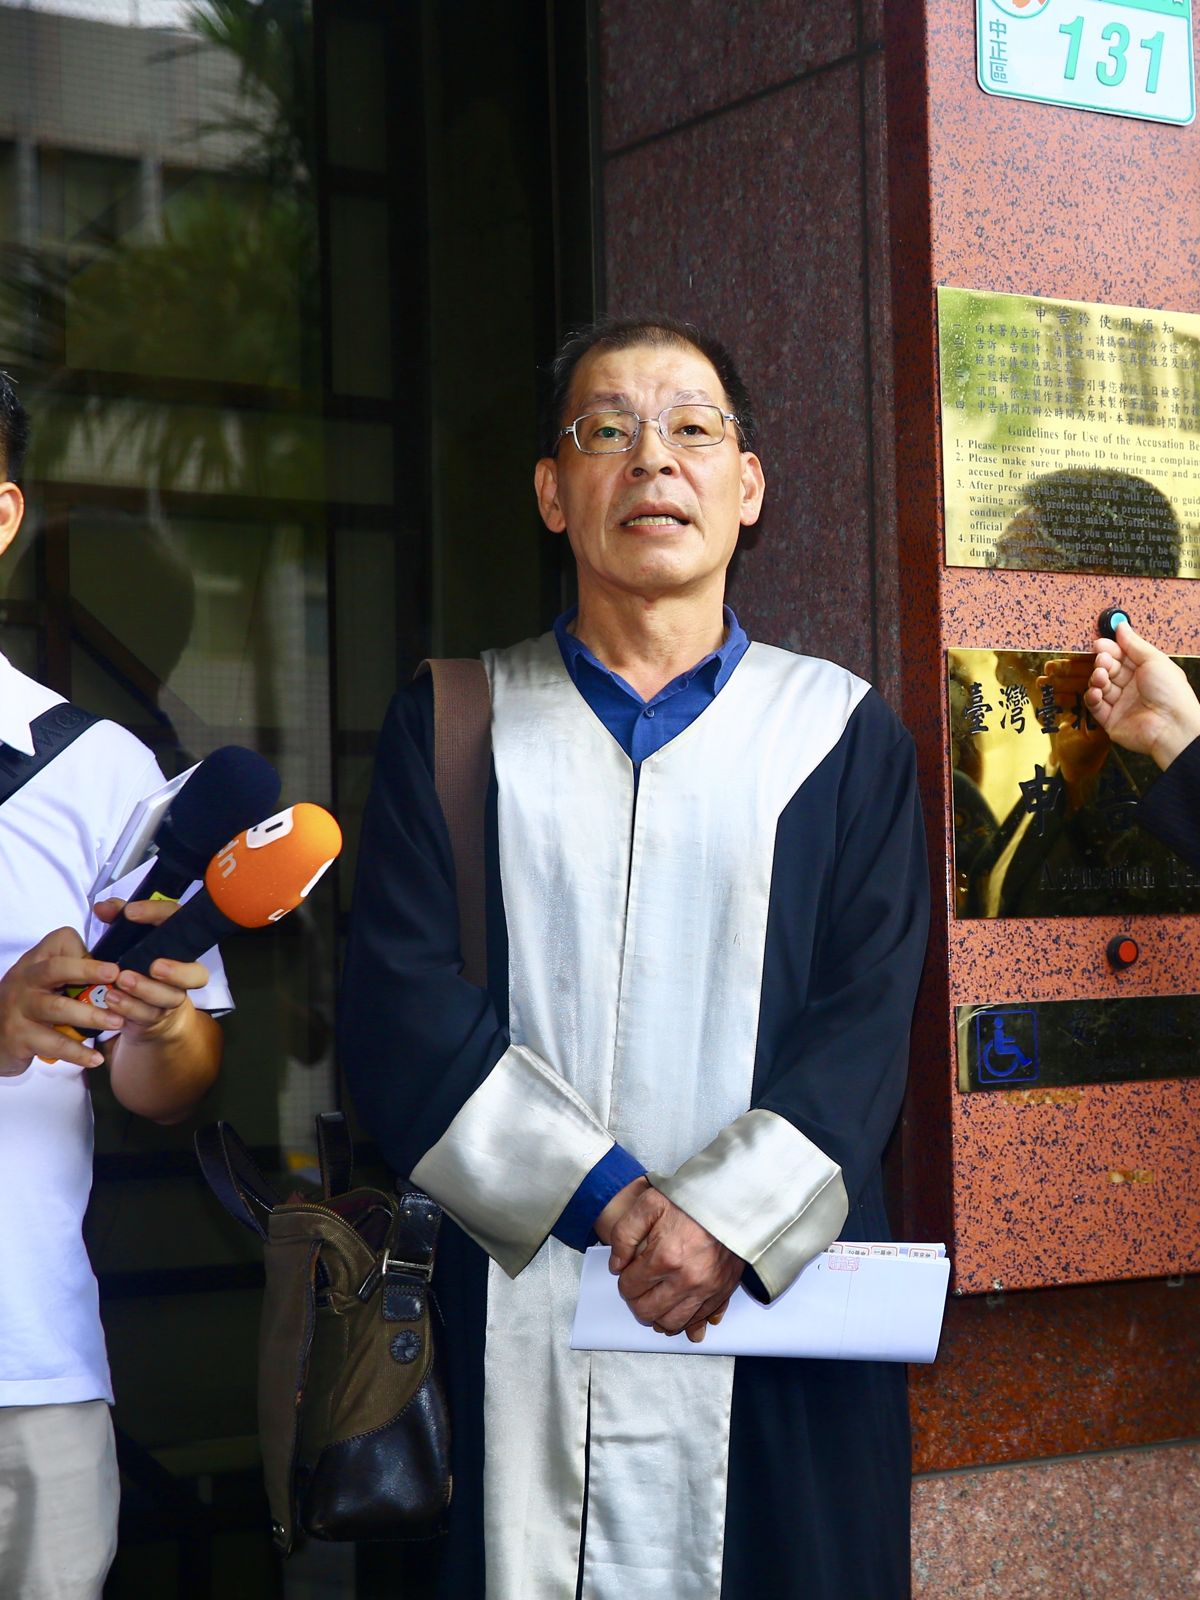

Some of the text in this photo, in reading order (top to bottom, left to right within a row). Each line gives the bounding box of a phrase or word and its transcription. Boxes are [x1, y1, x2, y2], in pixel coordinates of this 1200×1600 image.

[989, 19, 1008, 84] 中正區
[1059, 16, 1164, 94] 131
[1008, 425, 1059, 440] Guidelines
[1063, 430, 1077, 442] for
[1083, 431, 1099, 443] Use
[1103, 433, 1111, 444] of
[1116, 434, 1131, 446] the
[1135, 435, 1185, 450] Accusation
[955, 439, 964, 448] 1.
[968, 440, 997, 450] Please
[1002, 443, 1035, 455] present
[1040, 447, 1060, 457] your
[1065, 448, 1090, 460] photo
[1095, 450, 1106, 459] ID
[1110, 452, 1119, 460] to
[1123, 452, 1147, 463] bring
[956, 453, 964, 462] 2.
[969, 454, 998, 464] Please
[1002, 456, 1027, 466] make
[1031, 460, 1050, 468] sure
[1055, 461, 1064, 469] to
[1146, 469, 1169, 477] name
[1172, 469, 1188, 478] and
[968, 467, 1004, 478] accused
[1009, 470, 1023, 480] for
[956, 480, 965, 489] 3.
[969, 481, 994, 491] After
[970, 495, 1004, 506] waiting
[970, 508, 1006, 519] conduct
[970, 521, 1003, 532] official
[958, 534, 966, 544] 4.
[970, 535, 997, 546] Filing
[970, 548, 1000, 560] during
